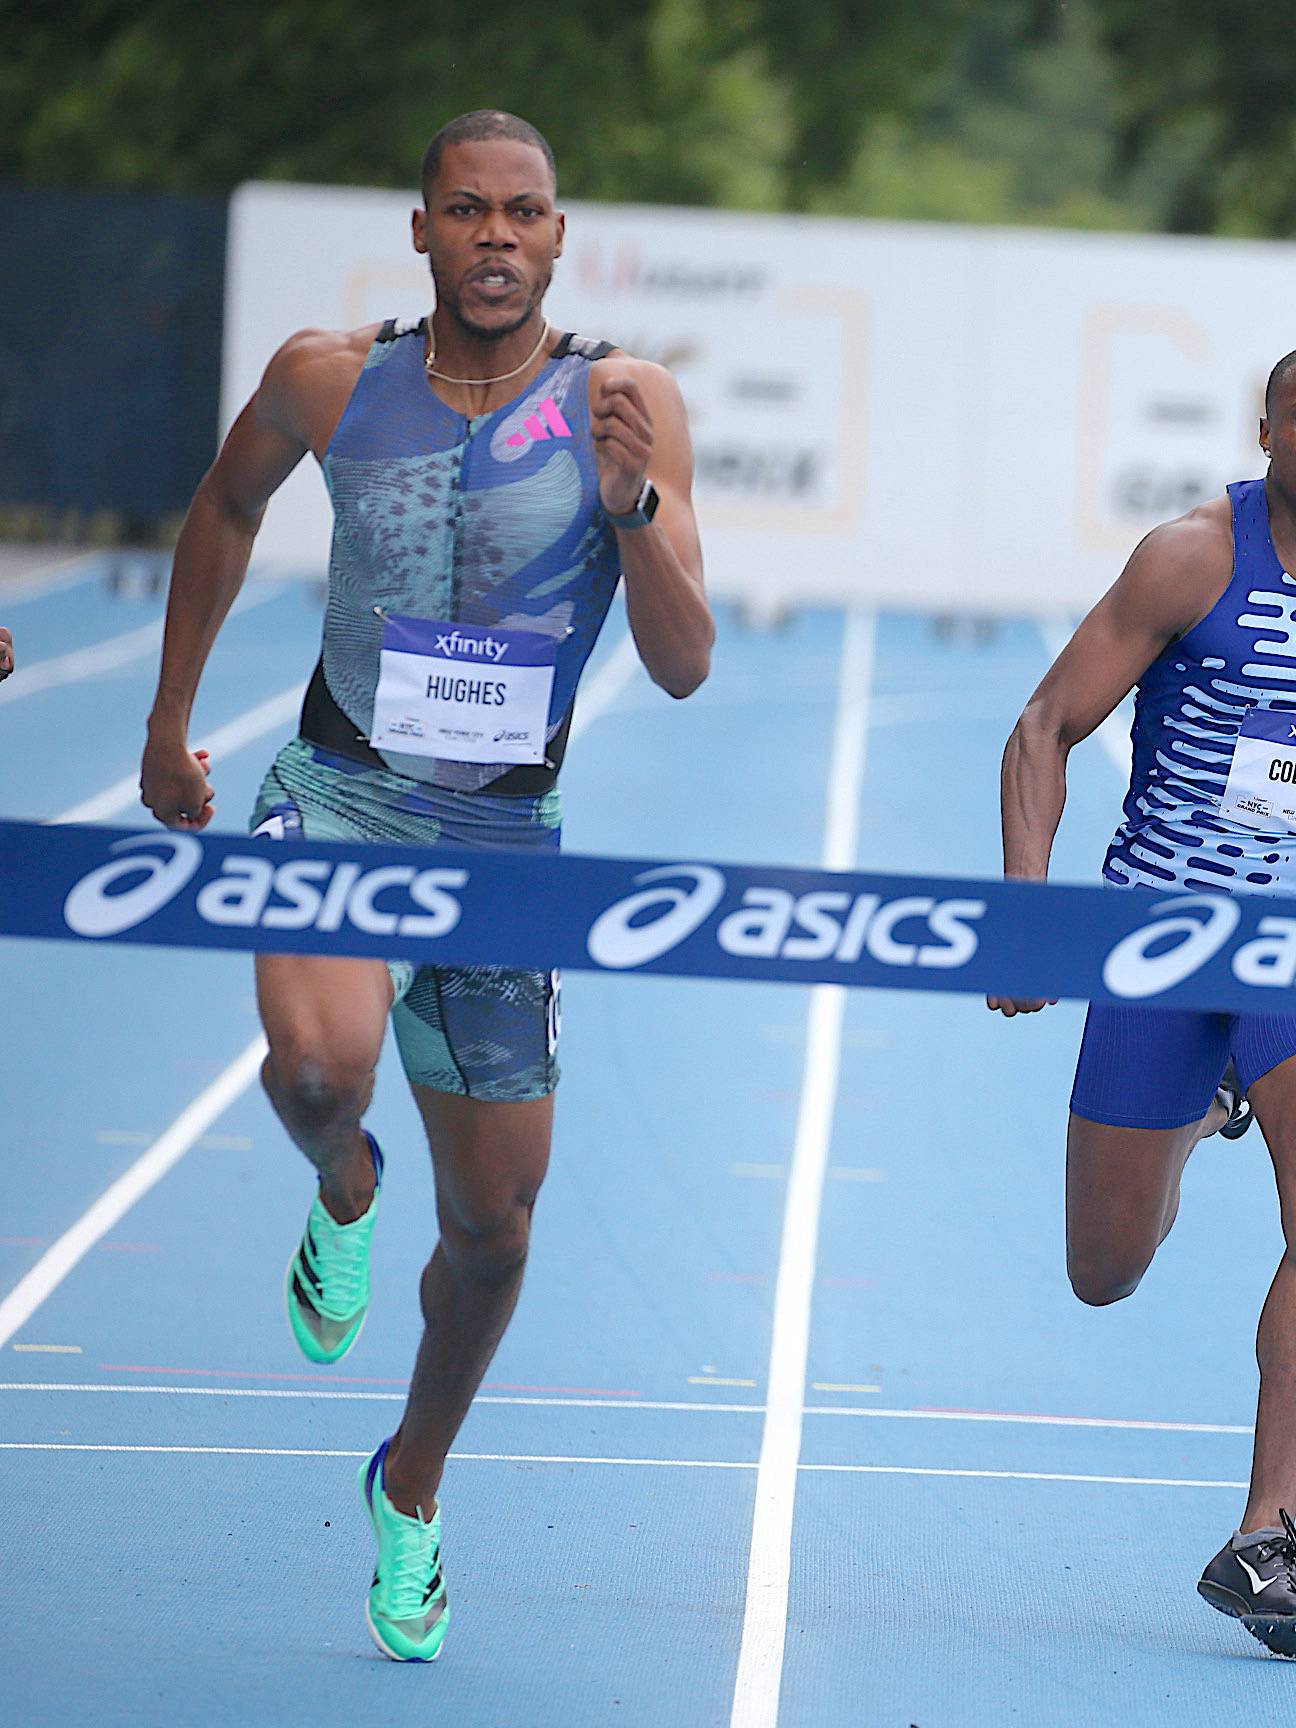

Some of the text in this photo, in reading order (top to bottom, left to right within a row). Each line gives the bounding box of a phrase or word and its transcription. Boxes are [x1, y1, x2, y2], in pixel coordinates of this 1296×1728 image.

[433, 630, 510, 662] xfinity
[425, 674, 507, 706] HUGHES
[198, 857, 466, 937] asics
[718, 887, 986, 968] asics
